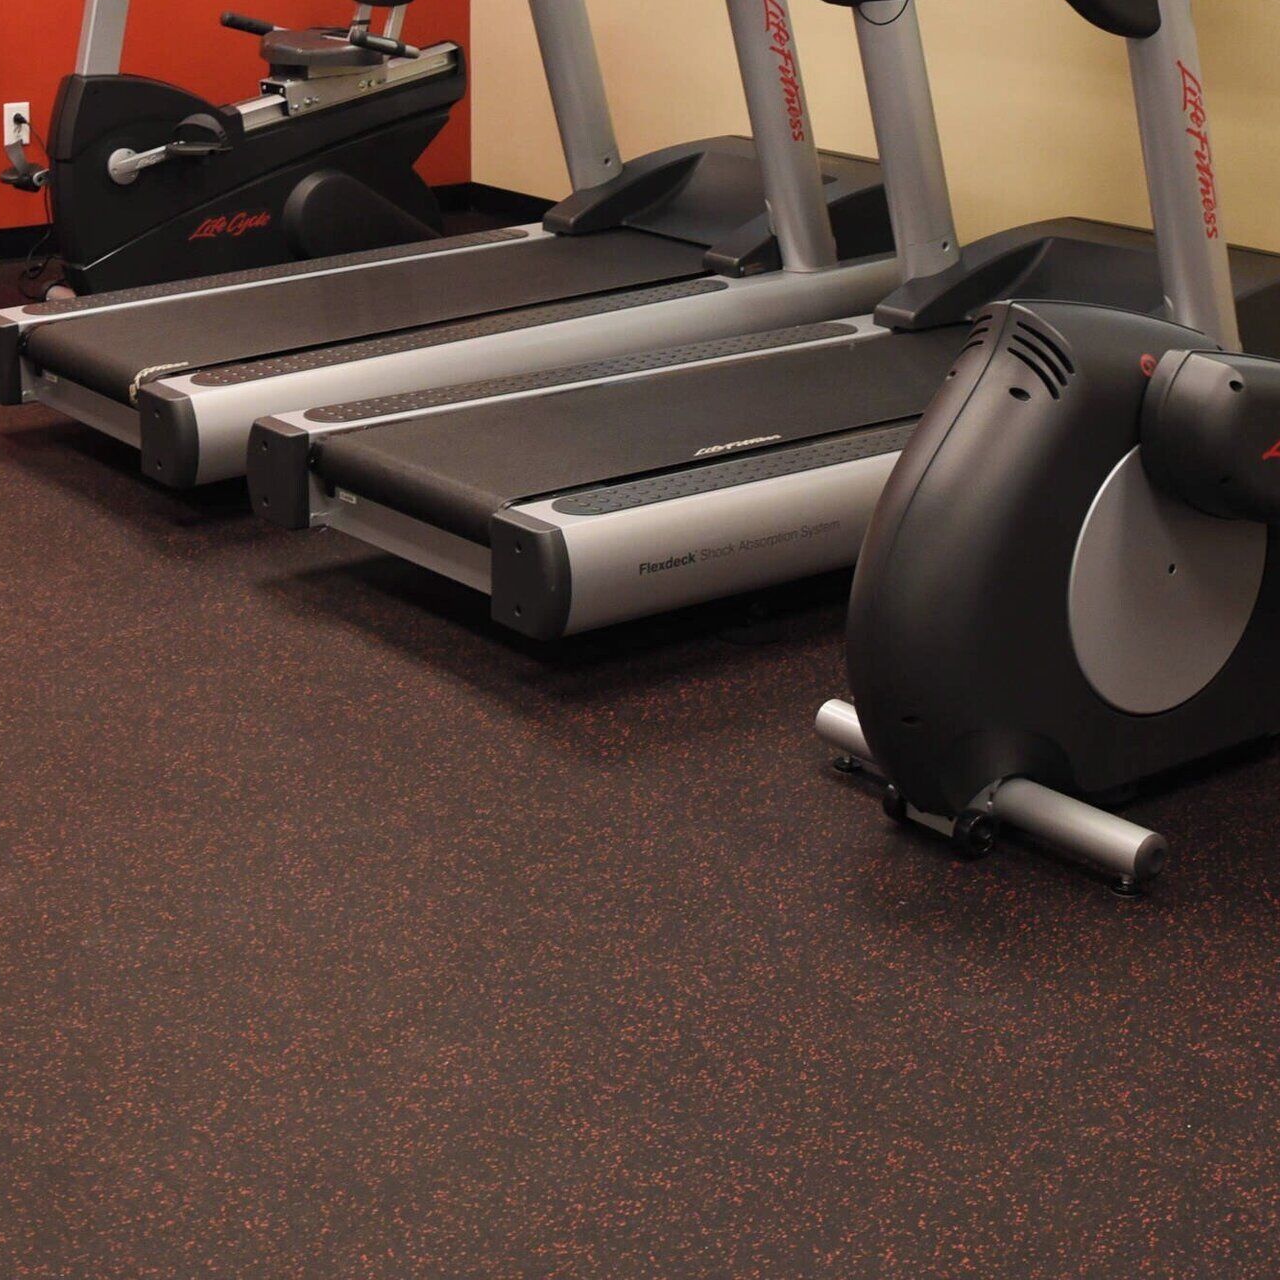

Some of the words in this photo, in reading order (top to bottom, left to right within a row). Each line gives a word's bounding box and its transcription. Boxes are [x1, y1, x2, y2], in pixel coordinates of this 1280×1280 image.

[770, 45, 805, 142] Fitness
[1177, 60, 1207, 129] Life
[1186, 127, 1218, 239] Fitness
[188, 216, 227, 241] Life
[226, 210, 271, 236] Cycle
[638, 551, 697, 576] Flexdeck
[700, 544, 735, 562] Shock
[738, 530, 799, 552] Absorption
[801, 520, 841, 539] System
